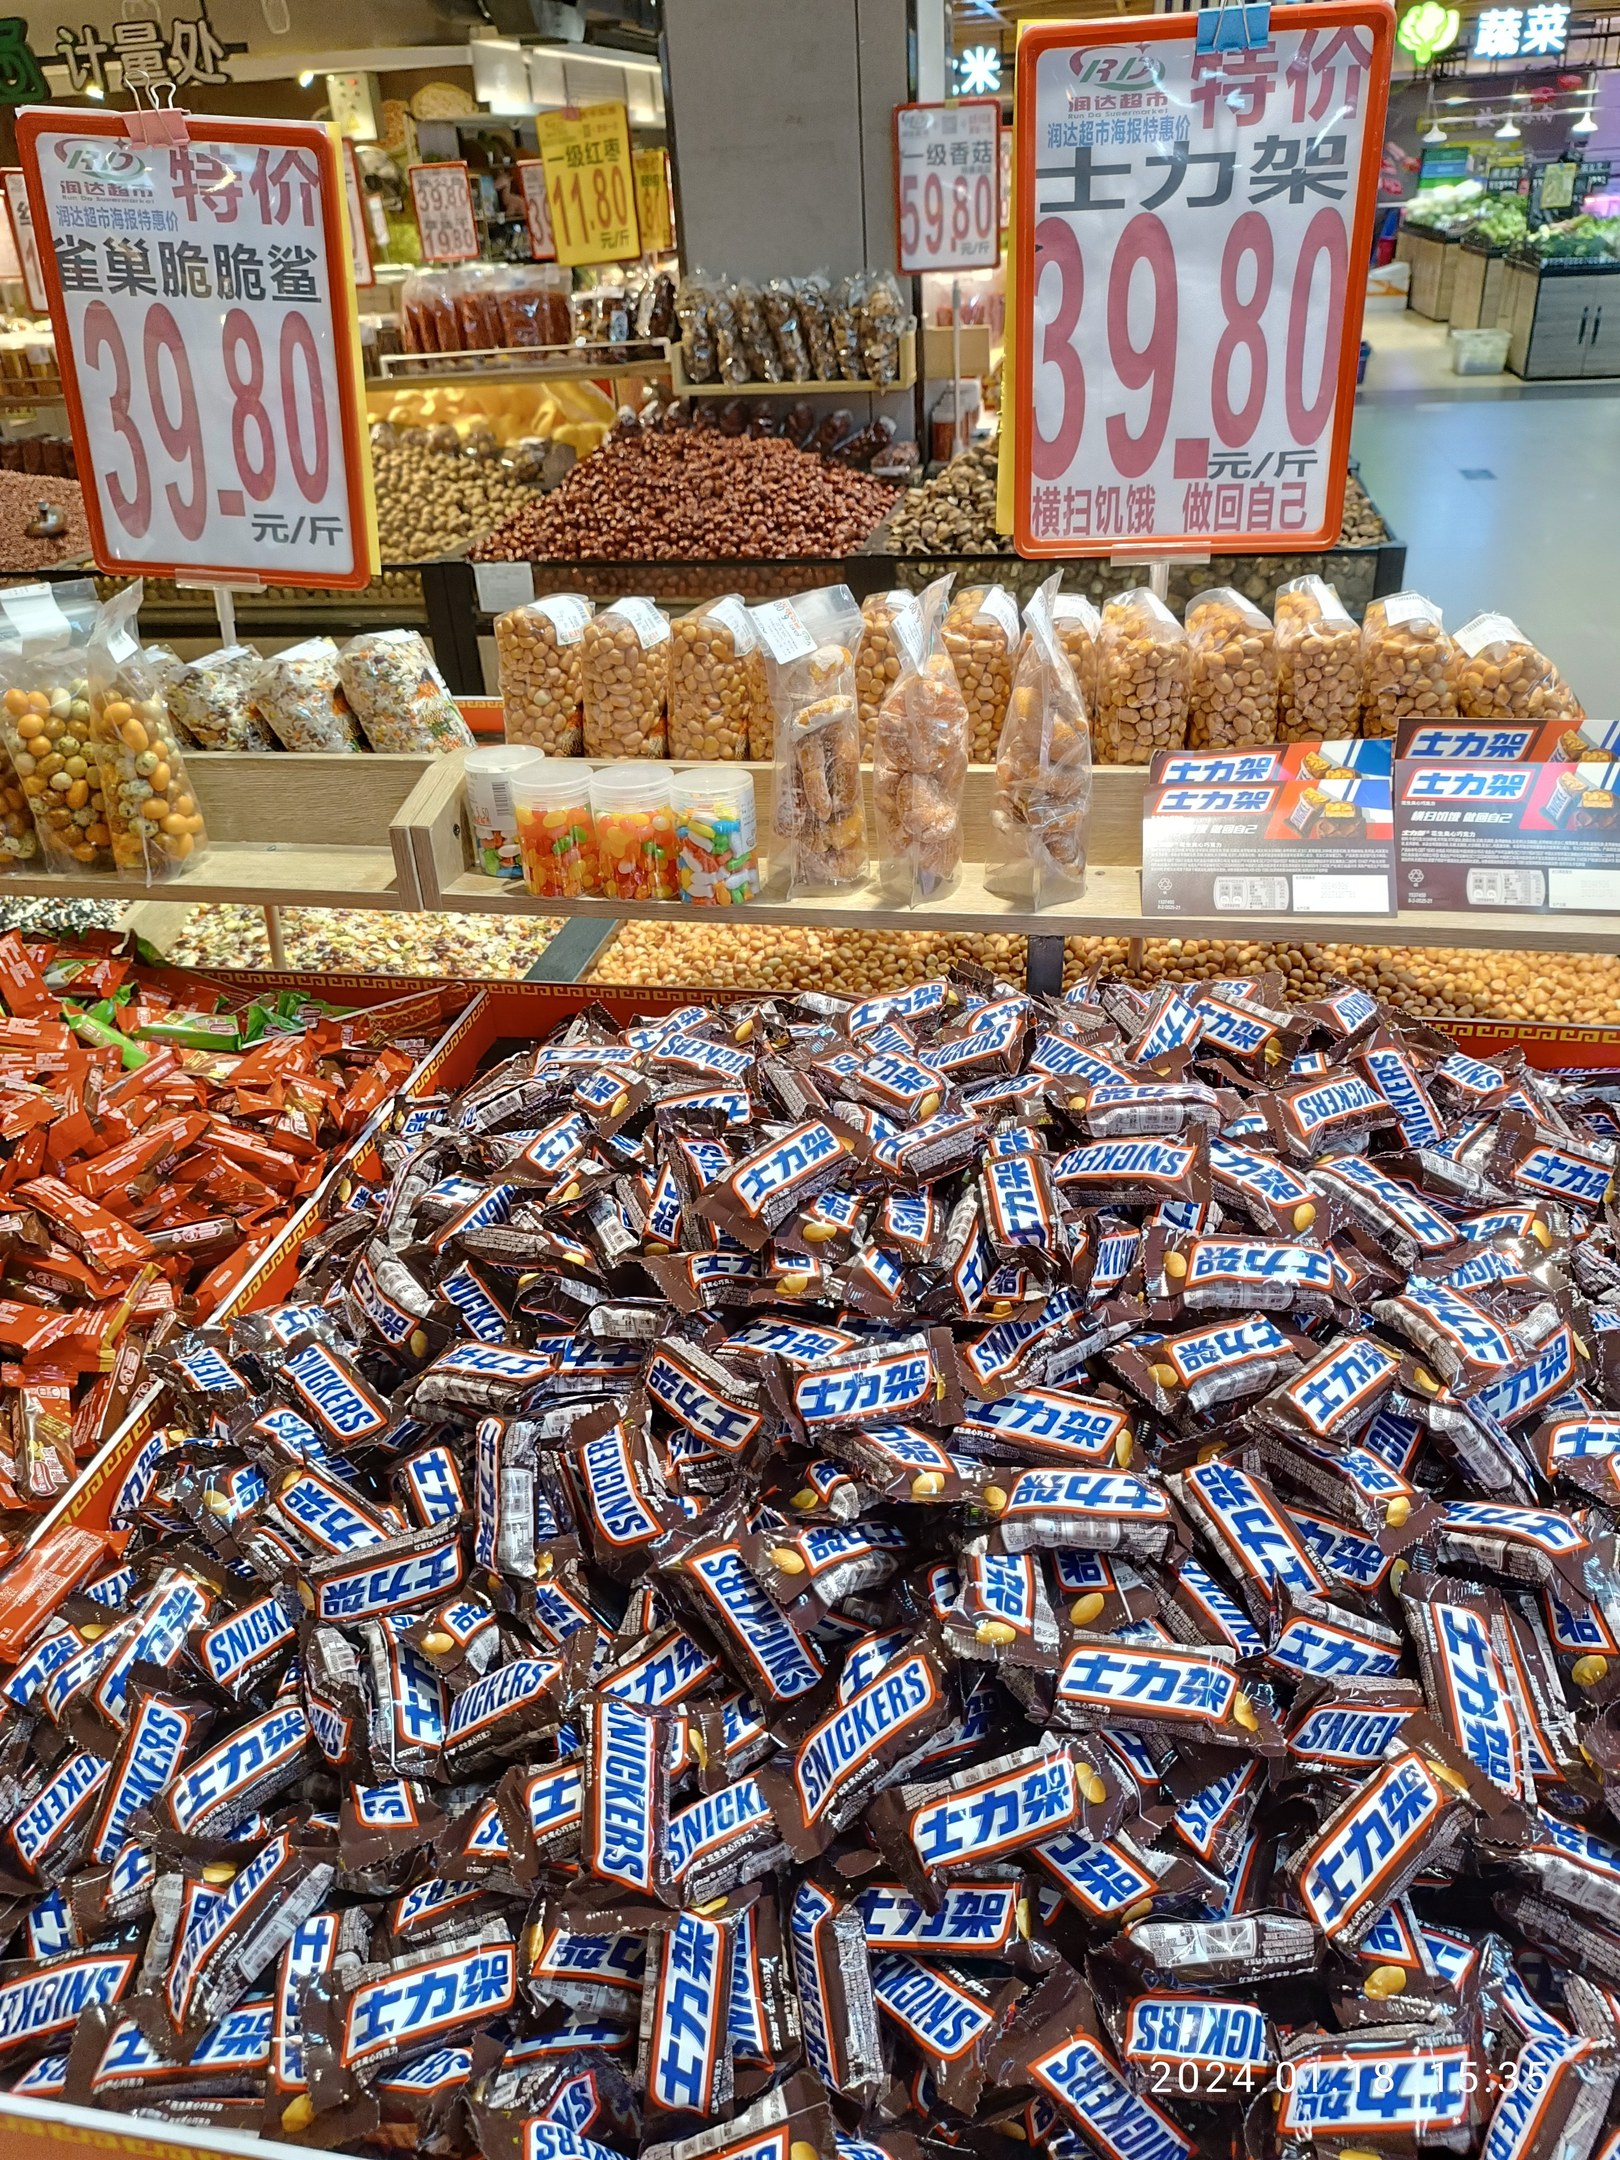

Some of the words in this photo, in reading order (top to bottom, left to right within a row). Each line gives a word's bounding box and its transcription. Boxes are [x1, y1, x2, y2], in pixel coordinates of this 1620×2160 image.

[57, 19, 229, 90] 计量处
[1191, 26, 1372, 130] 特价
[1047, 114, 1191, 149] 润达超市海报特惠价
[1068, 92, 1168, 112] 润达超市
[1105, 108, 1168, 118] Supermarket
[169, 146, 320, 226] 特价
[903, 140, 993, 166] 一级香菇
[1035, 135, 1349, 213] 士力架
[56, 205, 179, 232] 润达超市海报特惠价
[60, 180, 153, 198] 润达超市
[554, 165, 628, 246] 11.80
[901, 172, 992, 256] 59.80
[52, 235, 322, 303] 雀巢脆脆鲨
[1032, 208, 1348, 481] 39.80
[83, 299, 329, 542] 39.80
[1208, 449, 1319, 480] 元/斤
[252, 513, 344, 546] 元/斤
[1032, 484, 1156, 536] 横扫饥饿
[1182, 482, 1307, 534] 做回自己
[1166, 757, 1272, 783] 士力架
[1410, 731, 1529, 758] 士力架
[1162, 791, 1270, 810] 士力架
[1412, 773, 1526, 797] 士力架
[740, 1125, 836, 1203] 士力架
[1055, 1144, 1187, 1177] SNICKERS
[1333, 1160, 1447, 1245] 士力架
[1178, 1317, 1291, 1371] 士力架
[288, 1346, 375, 1438] SNICKERS
[649, 1360, 752, 1444] 士力架
[797, 1360, 928, 1418] 士力架
[1302, 1342, 1397, 1424] 士力架
[966, 1396, 1115, 1450] 士力架
[1010, 1473, 1167, 1509] 士力架
[1195, 1464, 1318, 1598] 士力架
[323, 1546, 456, 1613] 士力架
[702, 1551, 818, 1697] SNICKERS
[1064, 1654, 1231, 1714] 士力架
[1441, 1610, 1513, 1787] 士力架
[176, 1710, 304, 1825] 士力架
[801, 1660, 927, 1809] SNICKERS
[602, 1700, 649, 1881] SNICKERS
[920, 1763, 1073, 1862] 士力架
[1310, 1763, 1435, 1924] 士力架
[171, 1836, 283, 2019] SNICKERS
[855, 1890, 1006, 1939] 士力架
[354, 1954, 509, 2049] 士力架
[659, 1911, 717, 2108] 士力架
[1293, 2060, 1462, 2121] 士力架
